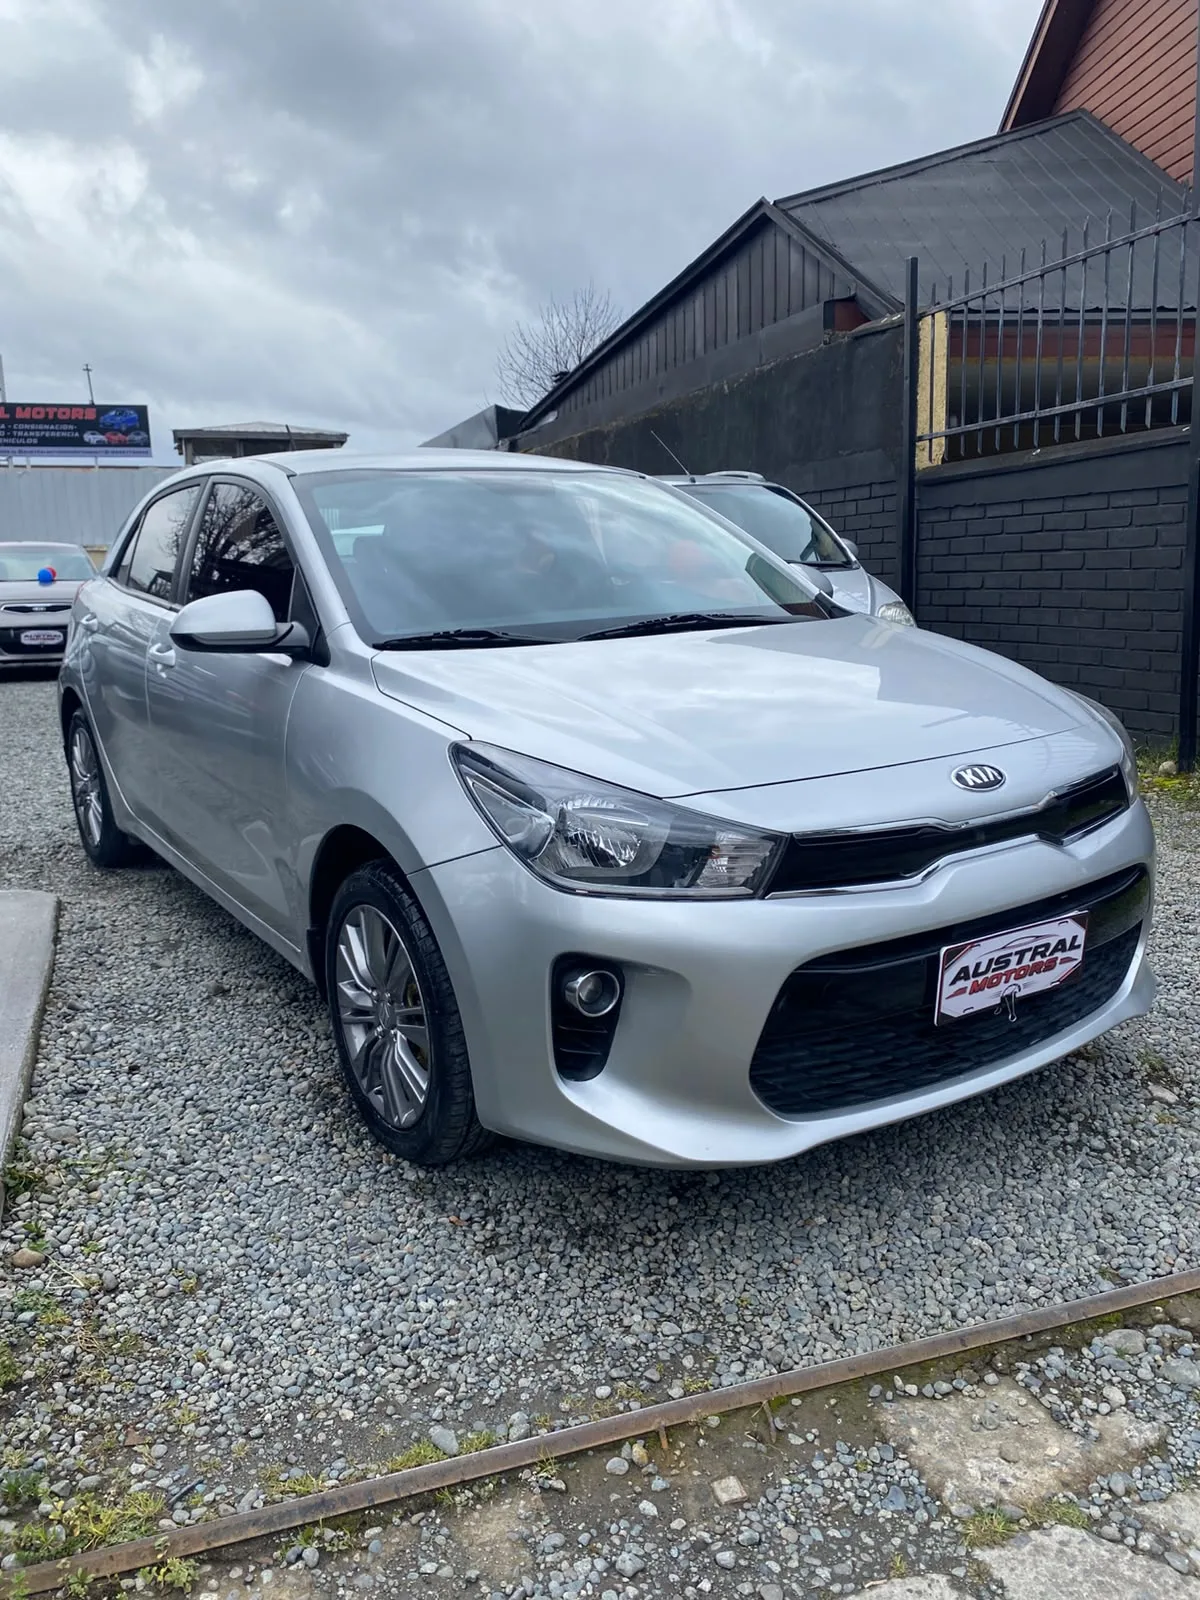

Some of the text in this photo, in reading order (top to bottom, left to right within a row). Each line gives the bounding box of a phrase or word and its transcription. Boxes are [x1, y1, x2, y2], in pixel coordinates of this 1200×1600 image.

[15, 406, 97, 420] MOTORS
[957, 766, 1002, 786] KIA
[949, 935, 1082, 986] AUSTRAL
[969, 957, 1058, 995] MOTORS
